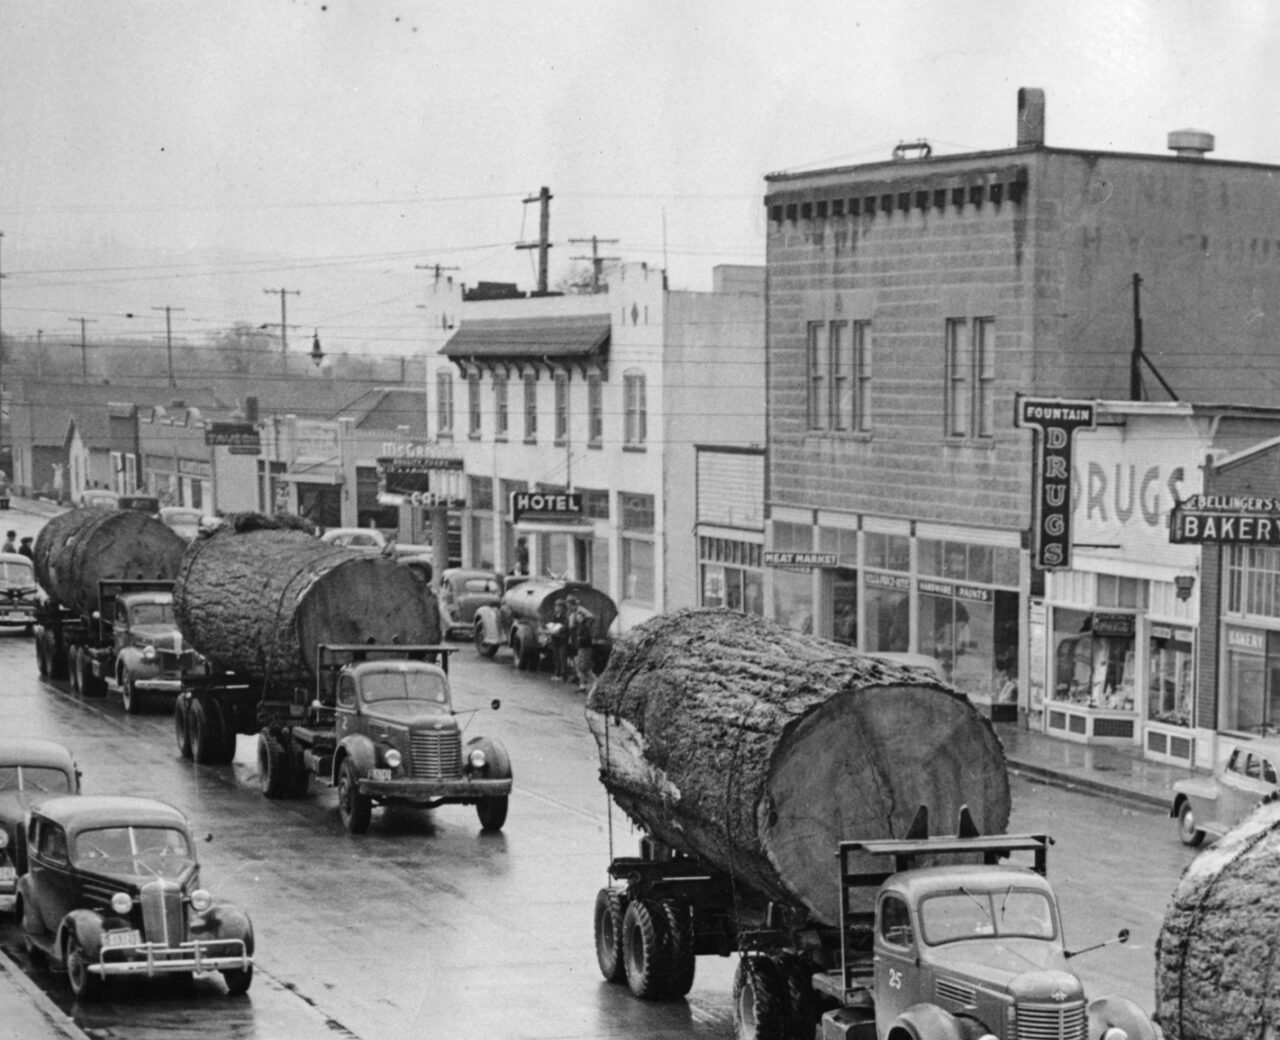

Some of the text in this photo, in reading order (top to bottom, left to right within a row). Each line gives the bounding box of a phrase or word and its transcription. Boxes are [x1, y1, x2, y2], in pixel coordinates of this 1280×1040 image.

[1026, 406, 1090, 421] FOUNTAIN
[517, 494, 579, 511] HOTEL
[1043, 426, 1068, 565] DRUGS
[765, 553, 836, 565] MEAT MARKET
[959, 586, 988, 601] PAINTS
[1228, 629, 1264, 649] BAKERY
[889, 967, 903, 990] 25
